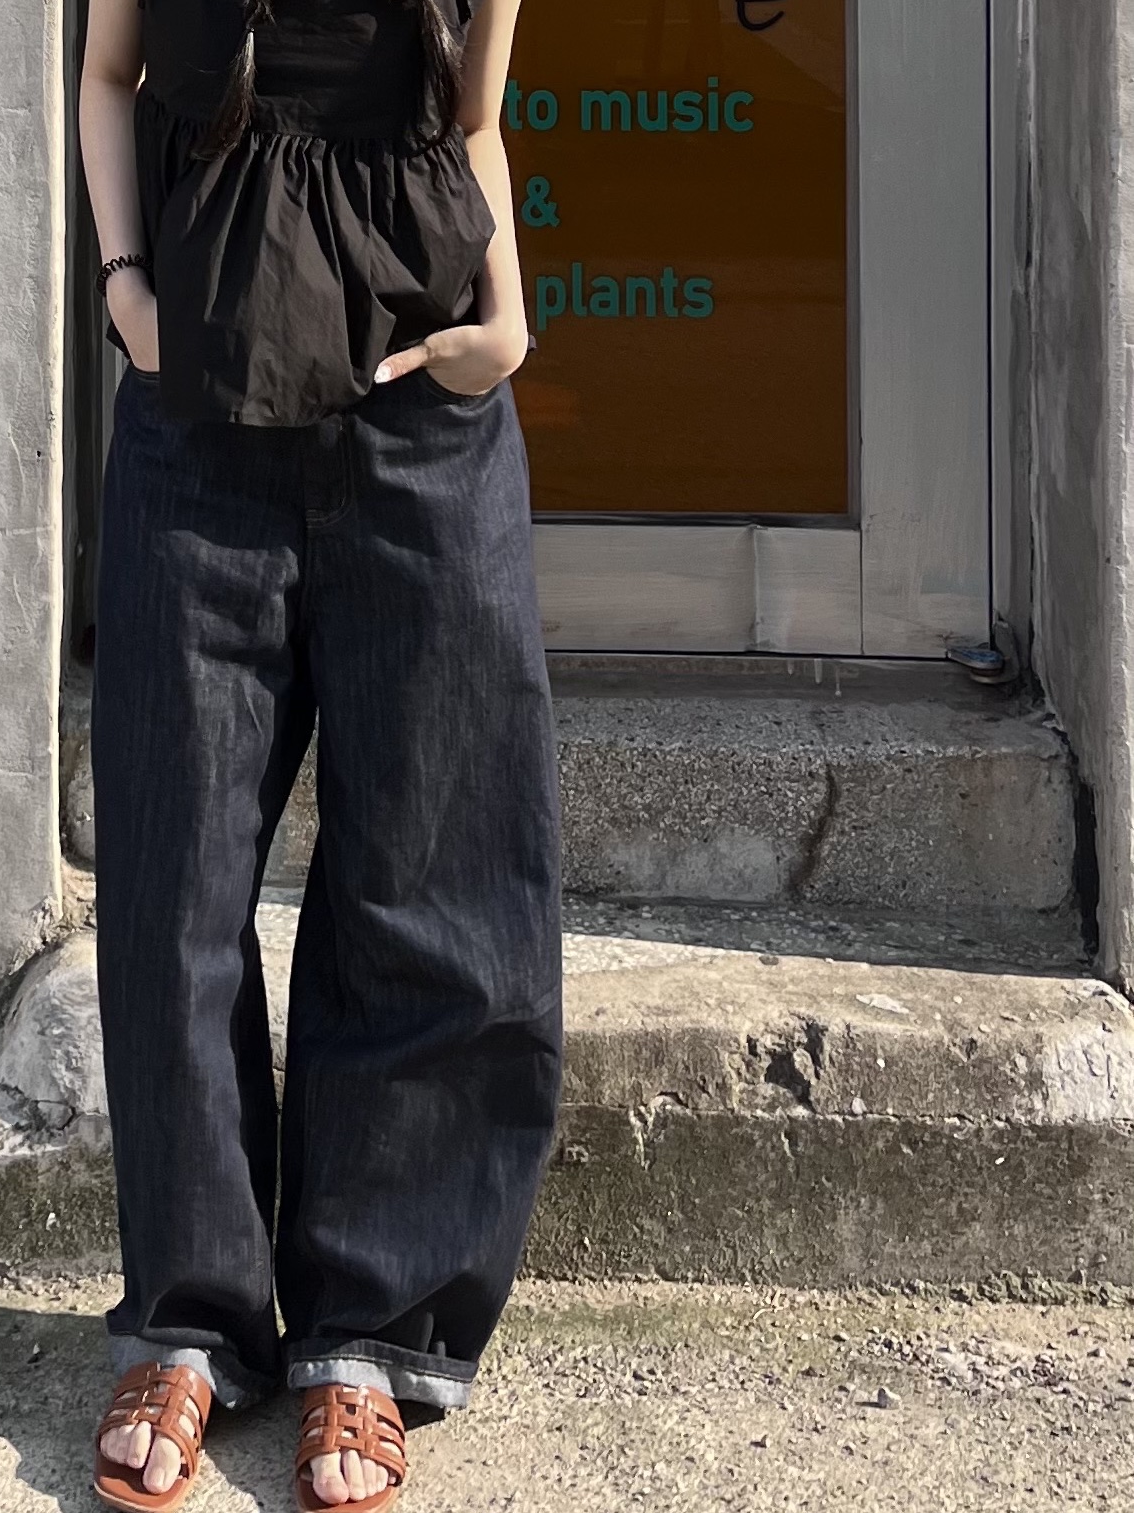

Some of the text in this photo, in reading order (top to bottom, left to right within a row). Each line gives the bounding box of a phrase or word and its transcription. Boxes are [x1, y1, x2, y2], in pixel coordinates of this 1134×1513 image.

[504, 77, 754, 133] to music
[521, 176, 560, 229] &
[536, 262, 714, 331] plants
